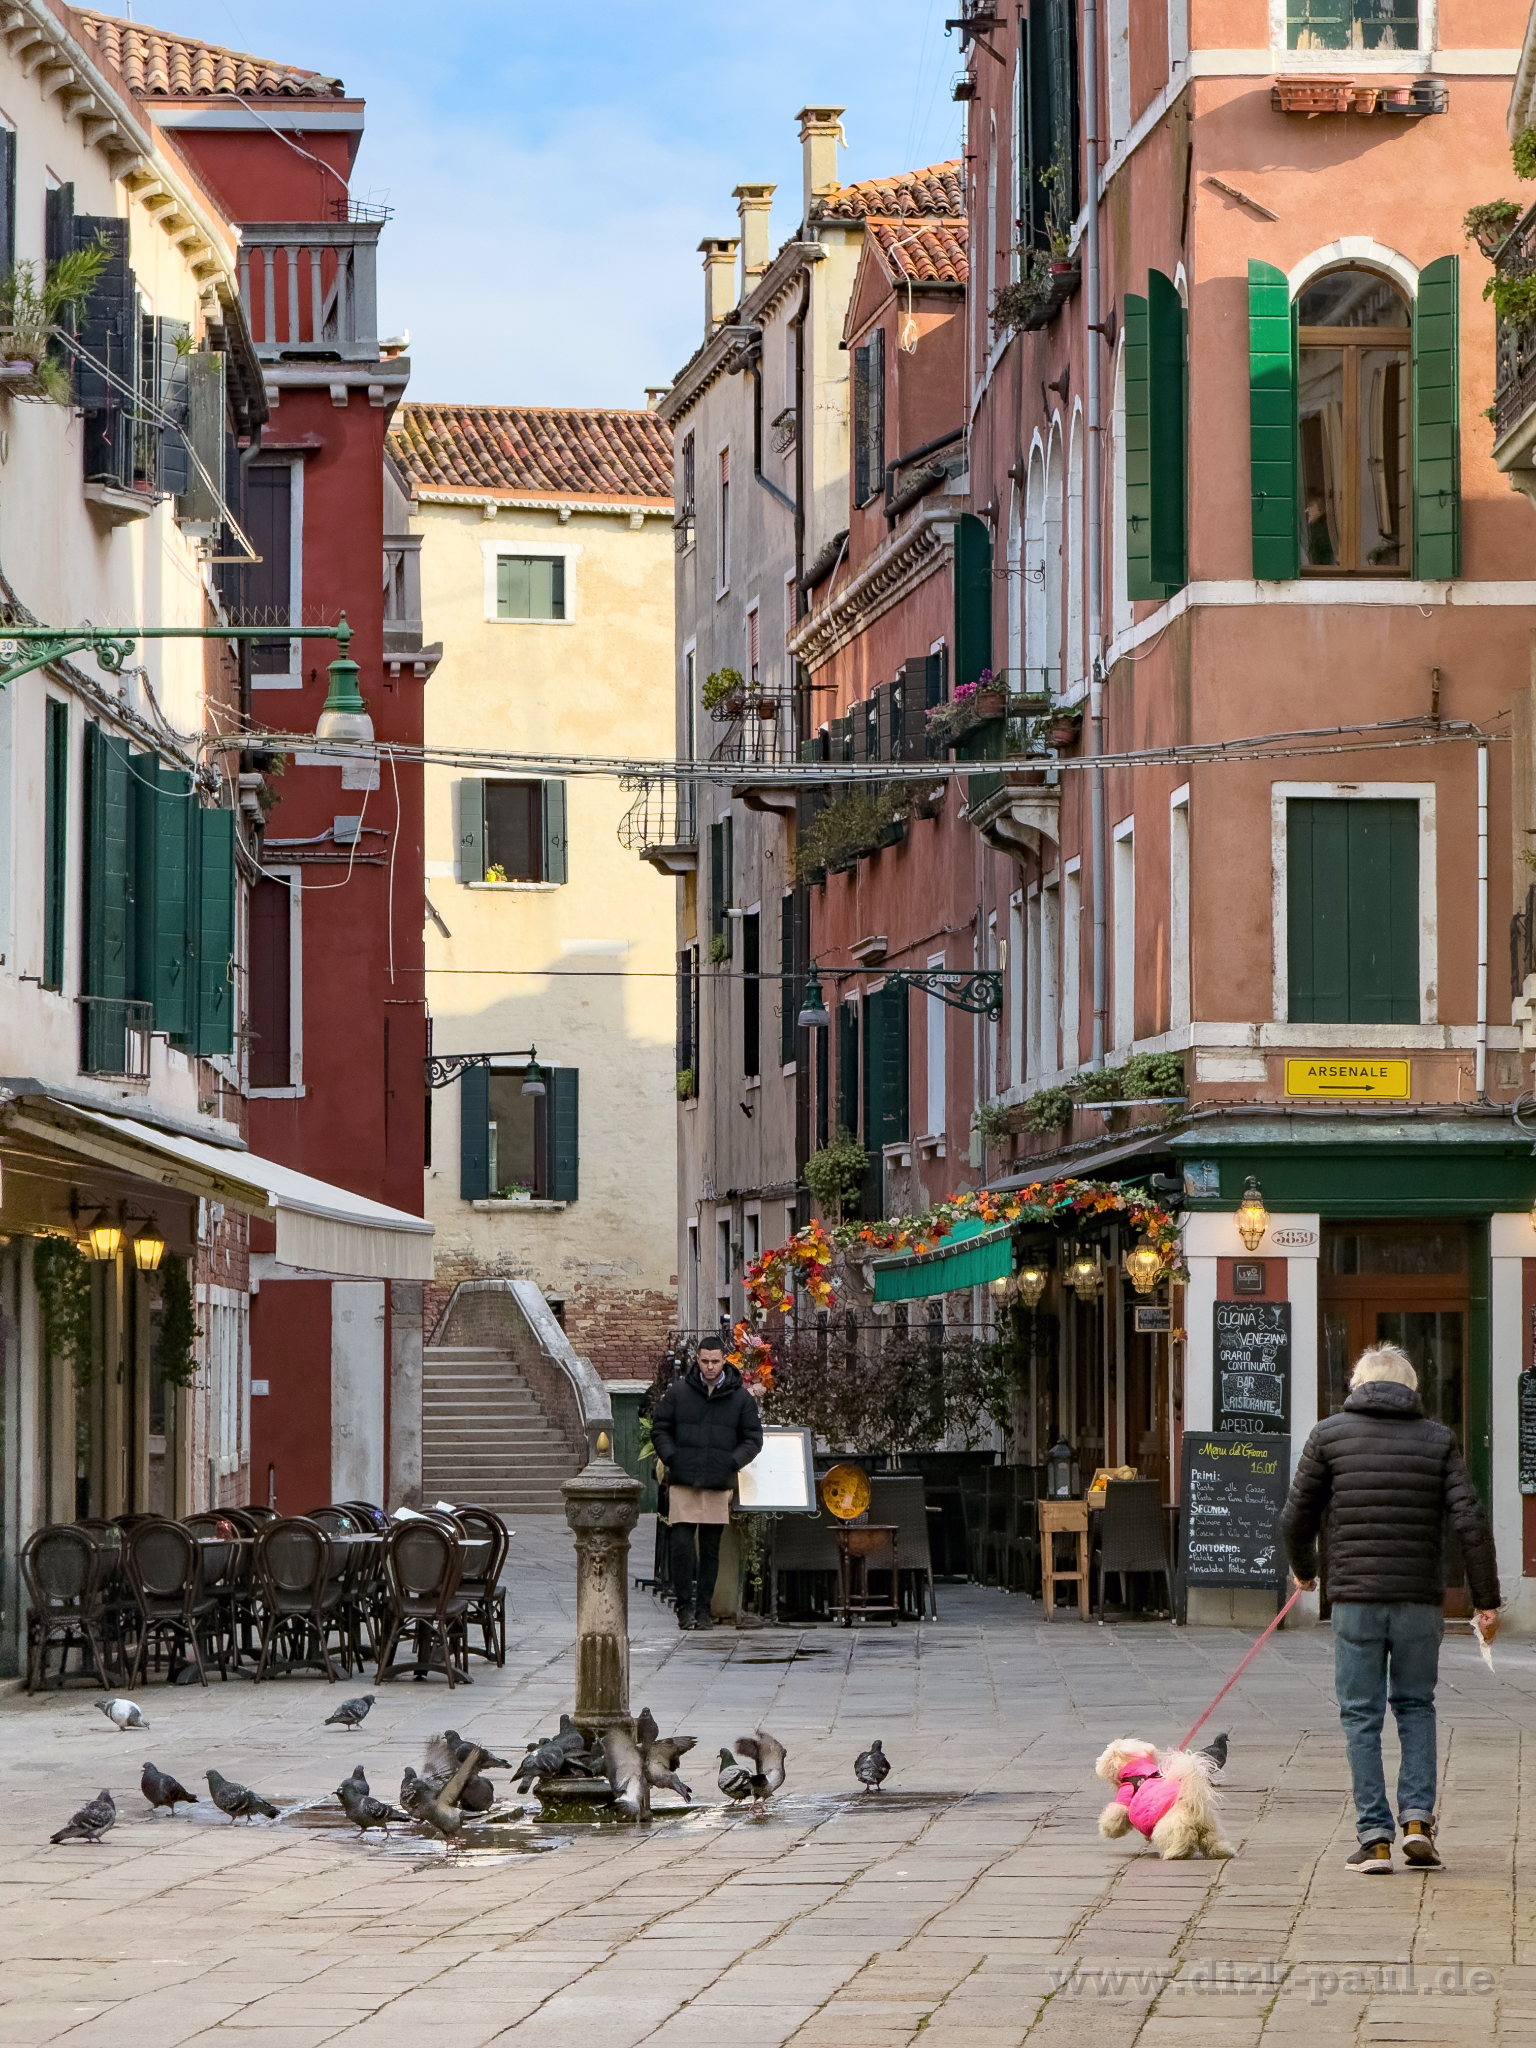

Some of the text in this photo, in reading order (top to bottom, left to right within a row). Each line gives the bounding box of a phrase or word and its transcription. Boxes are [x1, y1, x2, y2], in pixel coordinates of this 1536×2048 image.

[1307, 1066, 1388, 1077] ARSENALE
[1276, 1232, 1314, 1244] 3839
[1217, 1311, 1256, 1326] CUCINA
[1239, 1332, 1287, 1346] VENEZIANA
[1220, 1350, 1251, 1361] ORARIO
[1227, 1361, 1276, 1372] CONTINUATO
[1237, 1376, 1255, 1388] BAR
[1243, 1388, 1250, 1397] &
[1229, 1397, 1277, 1413] RISTORANTE
[1220, 1419, 1264, 1432] APERTO
[1198, 1442, 1268, 1460] Menu del Giorno
[1196, 1482, 1266, 1493] Pasta alle Cozze
[1195, 1516, 1221, 1526] Salmone
[1226, 1518, 1233, 1526] al
[1243, 1530, 1251, 1538] al
[1192, 1552, 1214, 1561] Patate
[1228, 1554, 1247, 1563] Forno
[1192, 1563, 1247, 1574] Insalata Mista
